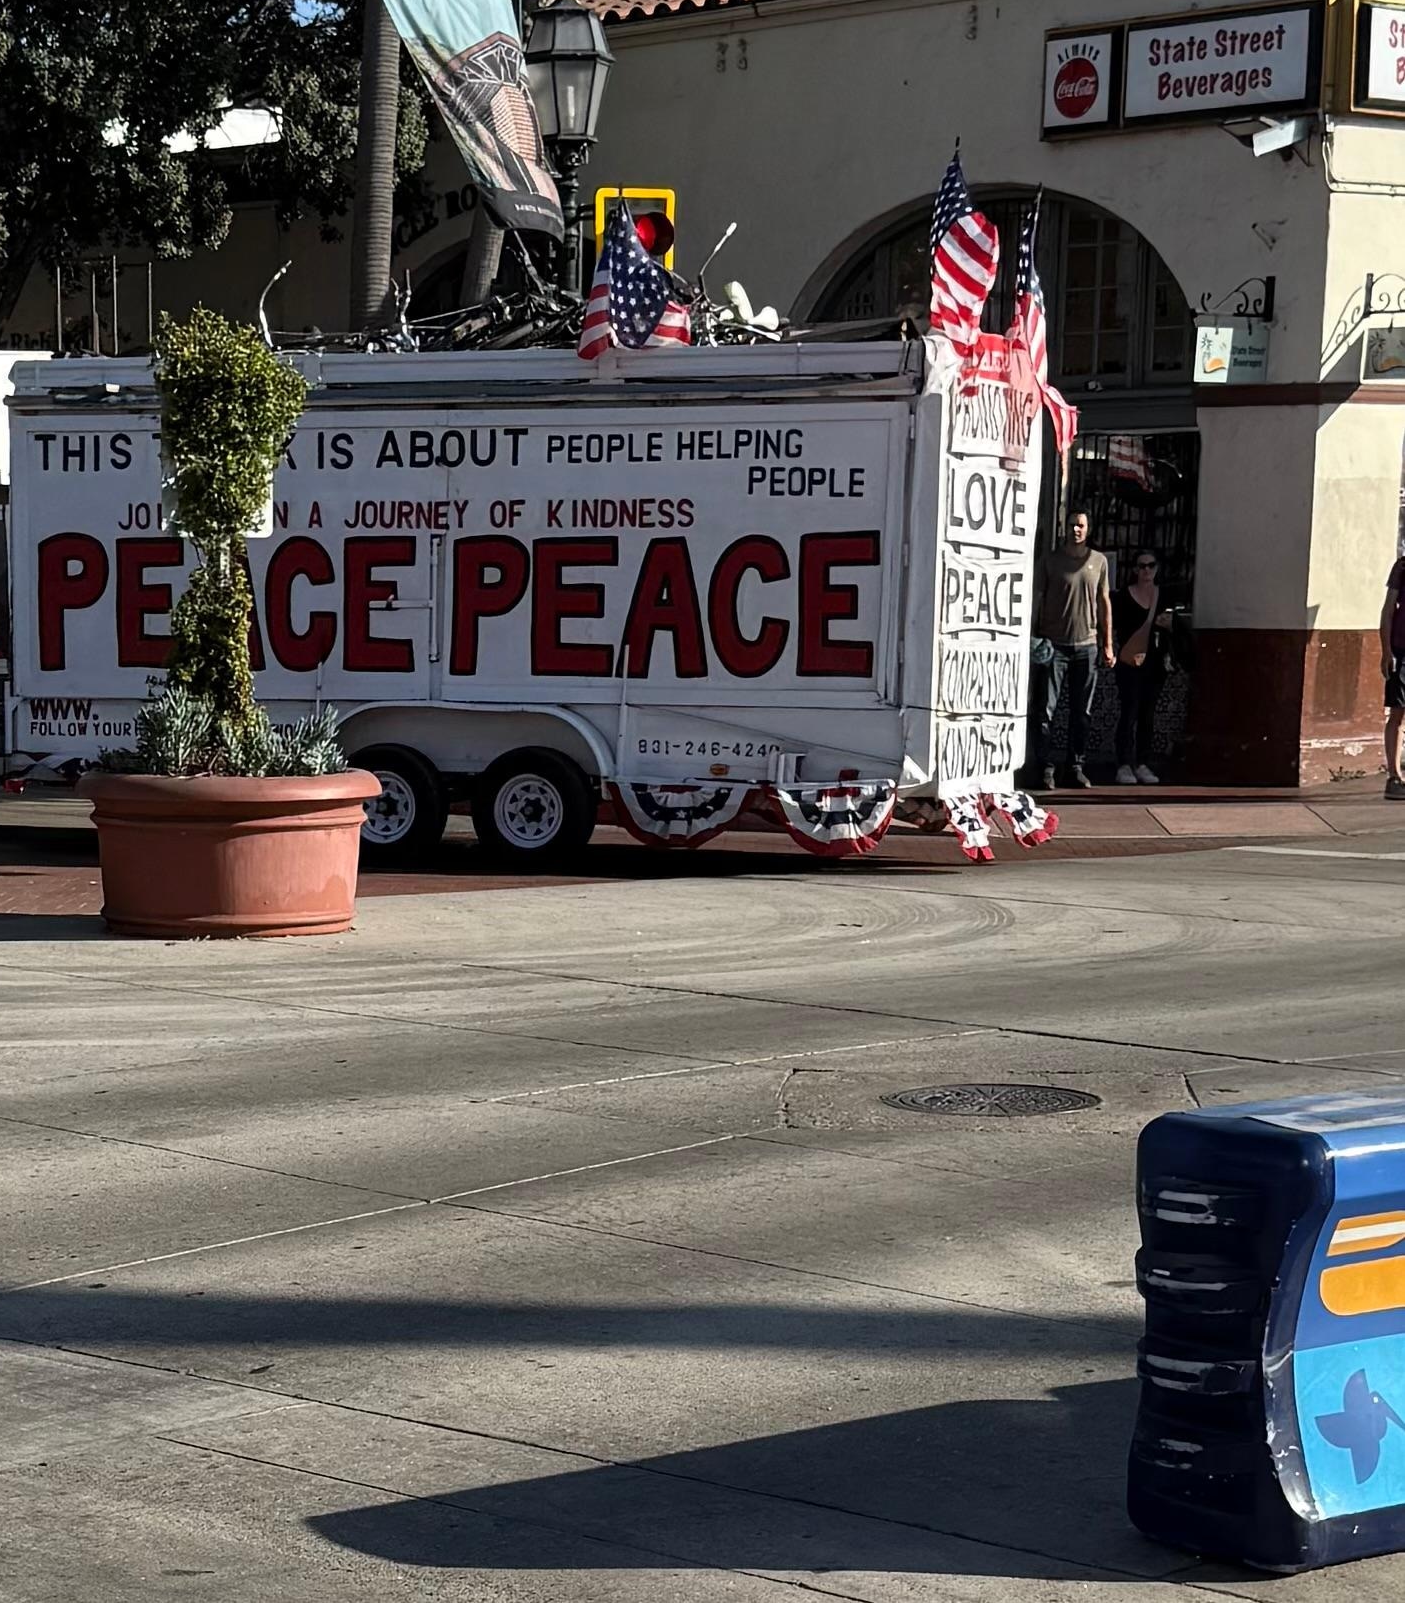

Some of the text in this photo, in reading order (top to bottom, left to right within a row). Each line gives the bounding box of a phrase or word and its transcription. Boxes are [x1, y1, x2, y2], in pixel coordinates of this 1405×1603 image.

[1149, 24, 1286, 66] State Street
[1157, 67, 1273, 101] Beverages
[34, 433, 133, 472] THIS
[317, 432, 354, 470] IS
[376, 428, 529, 469] ABOUT
[546, 432, 664, 463] PEOPLE
[676, 429, 803, 462] HELPING
[748, 466, 866, 497] PEOPLE
[949, 468, 1027, 537] LOVE
[308, 501, 323, 529] A
[344, 500, 469, 530] JOURNEY
[489, 499, 526, 529] OF
[547, 498, 695, 529] KINDNESS
[449, 530, 881, 678] PEACE
[946, 568, 1024, 627] PEACE
[30, 698, 100, 721] WWW.
[940, 722, 1016, 781] KINDNESS
